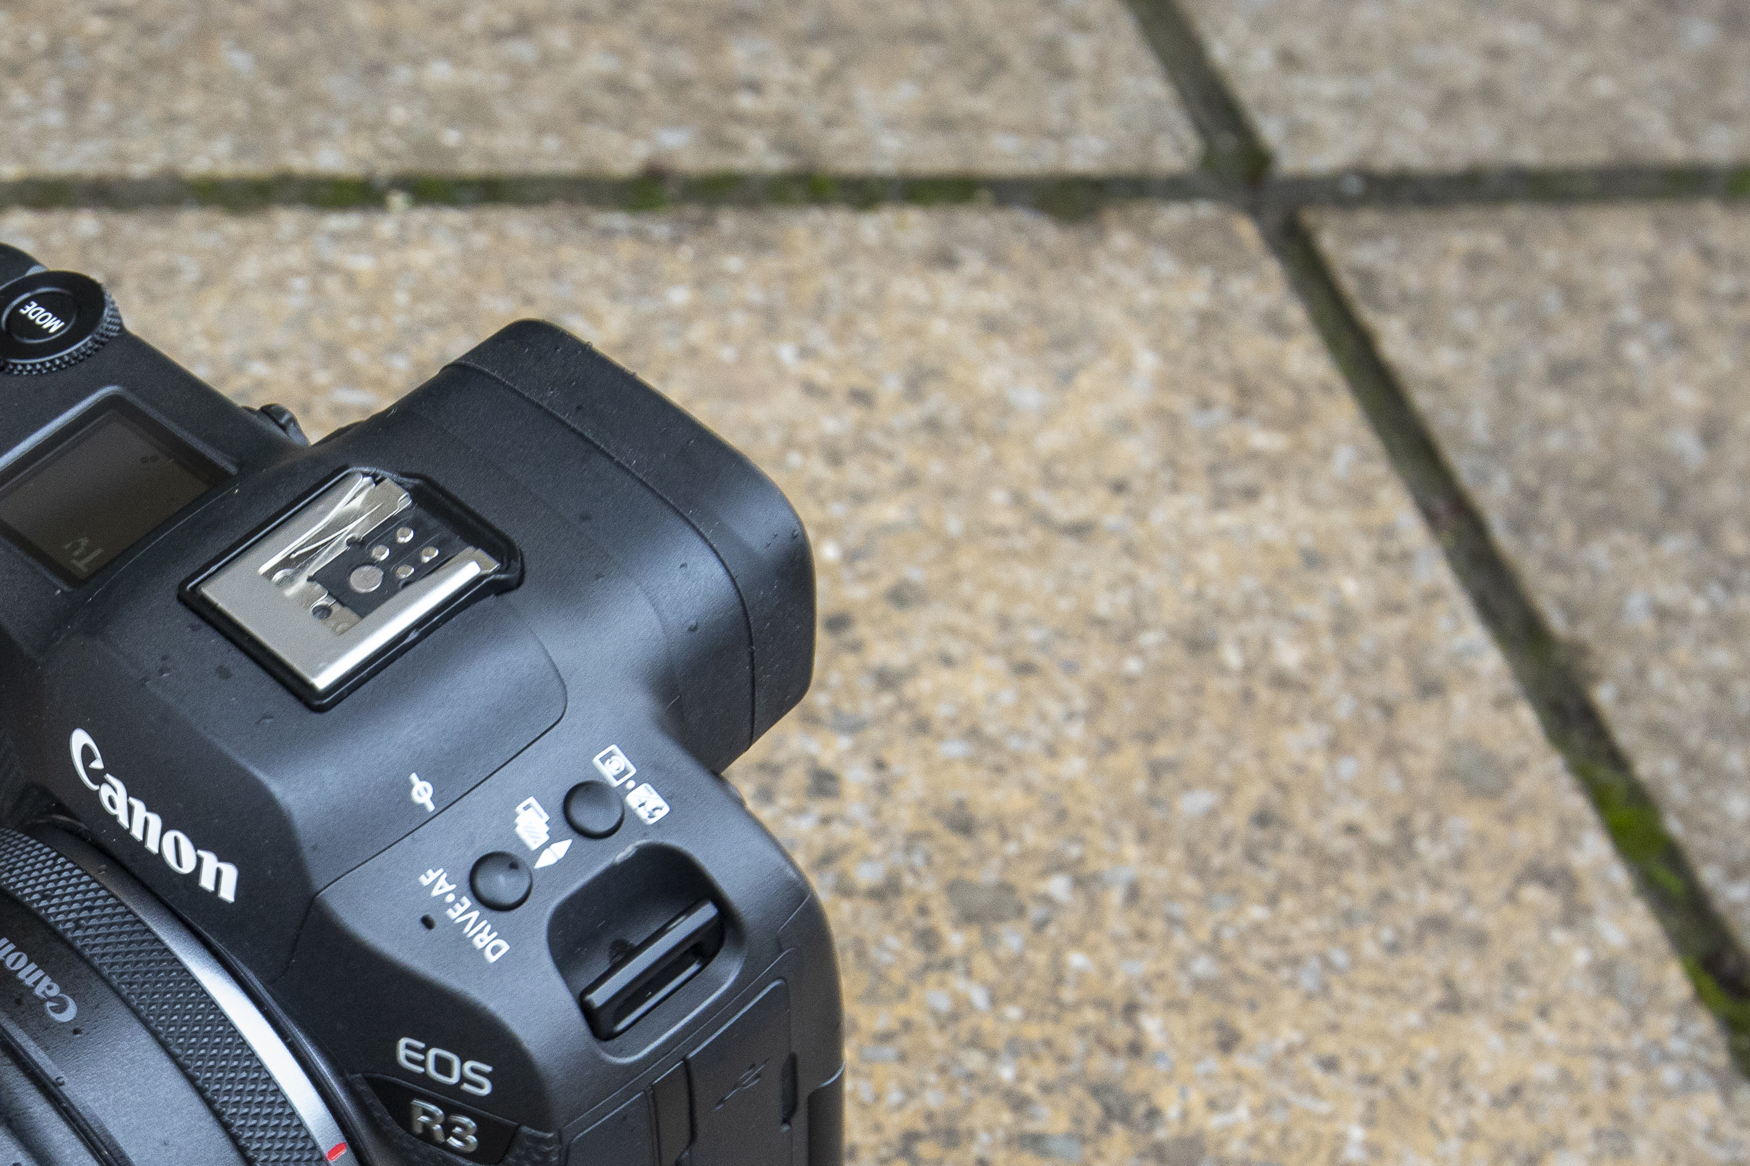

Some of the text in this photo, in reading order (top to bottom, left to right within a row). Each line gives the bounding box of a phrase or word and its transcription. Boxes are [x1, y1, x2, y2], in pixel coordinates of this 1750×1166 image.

[19, 301, 65, 333] MODE
[70, 728, 238, 903] Canon
[396, 1037, 493, 1096] EOS
[411, 1098, 478, 1153] R3
